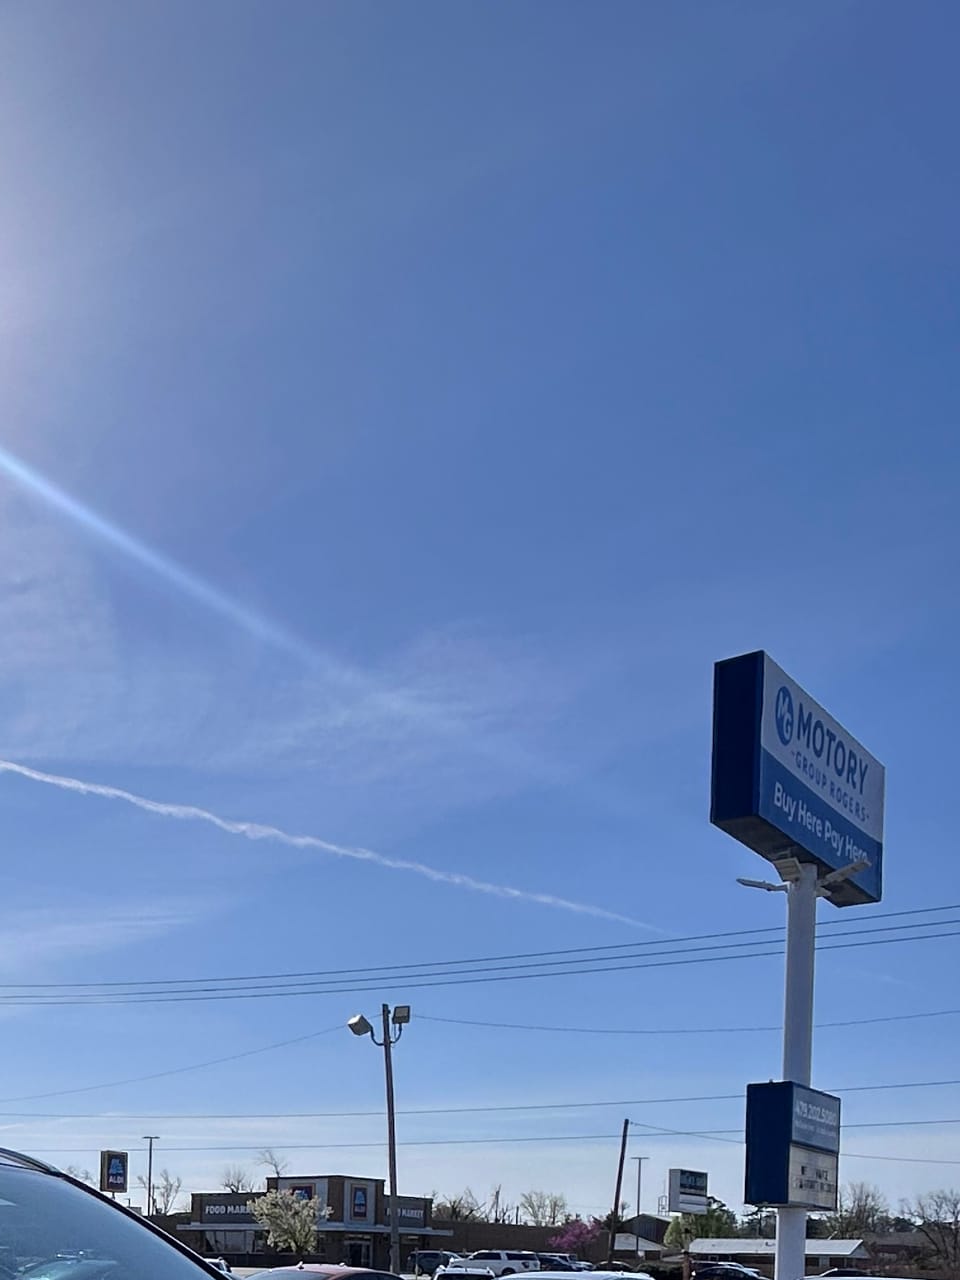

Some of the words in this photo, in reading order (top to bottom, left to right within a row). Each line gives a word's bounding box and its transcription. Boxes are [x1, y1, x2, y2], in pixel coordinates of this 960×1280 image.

[777, 689, 792, 739] MG
[797, 703, 869, 794] MOTORY
[796, 751, 826, 789] GROUP
[830, 782, 865, 822] ROGERS
[774, 781, 796, 820] Buy
[797, 802, 822, 838] Here
[824, 819, 846, 857] Pay
[109, 1175, 124, 1184] ALDI
[205, 1205, 226, 1214] FOOD
